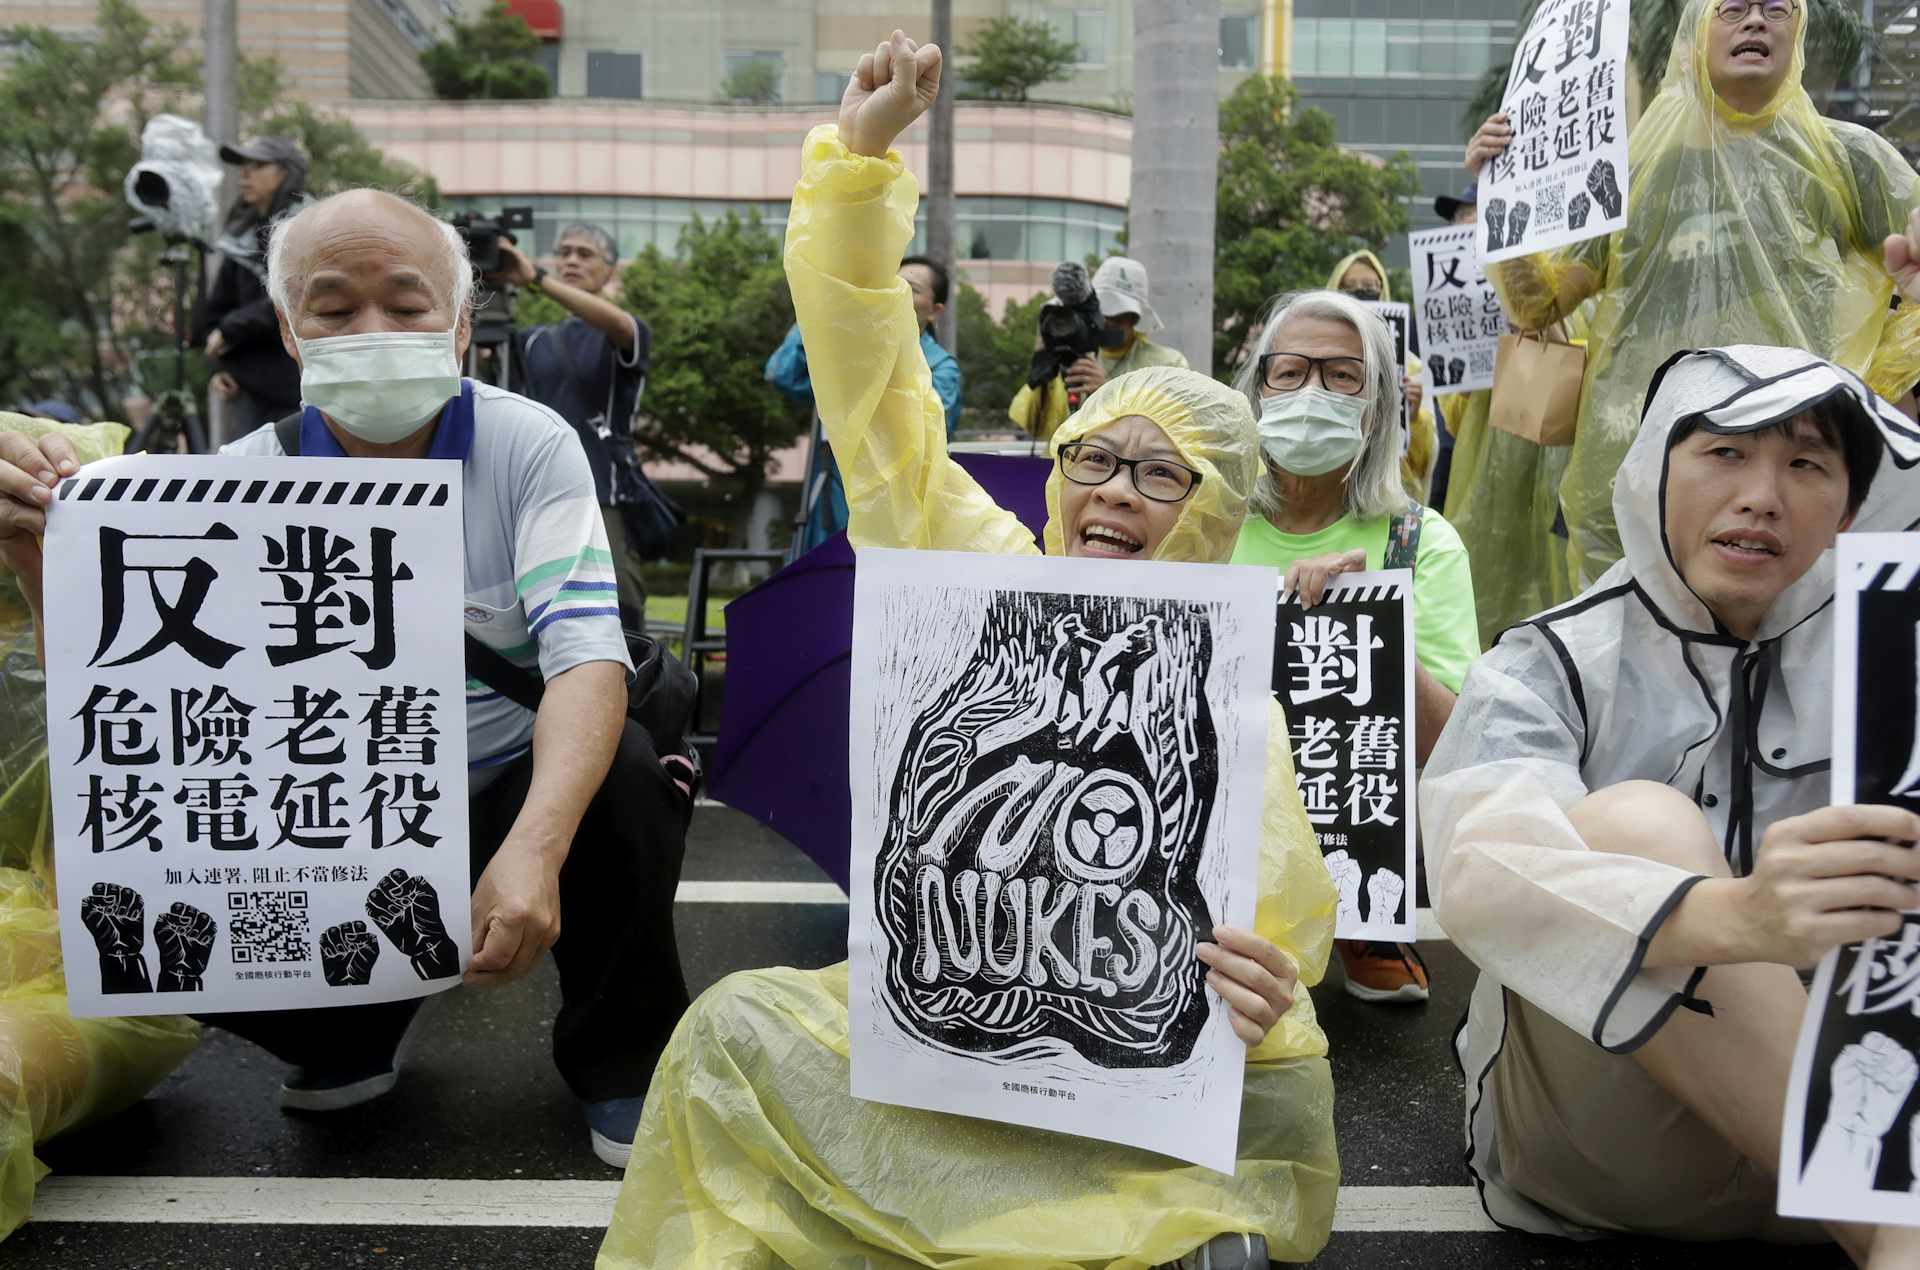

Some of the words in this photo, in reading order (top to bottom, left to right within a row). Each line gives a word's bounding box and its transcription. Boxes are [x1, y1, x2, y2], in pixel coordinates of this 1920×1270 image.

[1508, 0, 1611, 97] 反對
[1487, 106, 1616, 185] 核電延役
[1425, 245, 1487, 292] 反
[87, 522, 413, 670] 反對
[1270, 614, 1385, 707] 對
[69, 684, 441, 767] 危險老舊
[1289, 715, 1400, 770] 老舊
[77, 772, 443, 854] 核電延役
[1296, 772, 1400, 827] 延役
[914, 864, 1160, 997] NUKES
[235, 970, 312, 980] 全國廢核行動平台
[1002, 1081, 1076, 1101] 全國廢核行動平台
